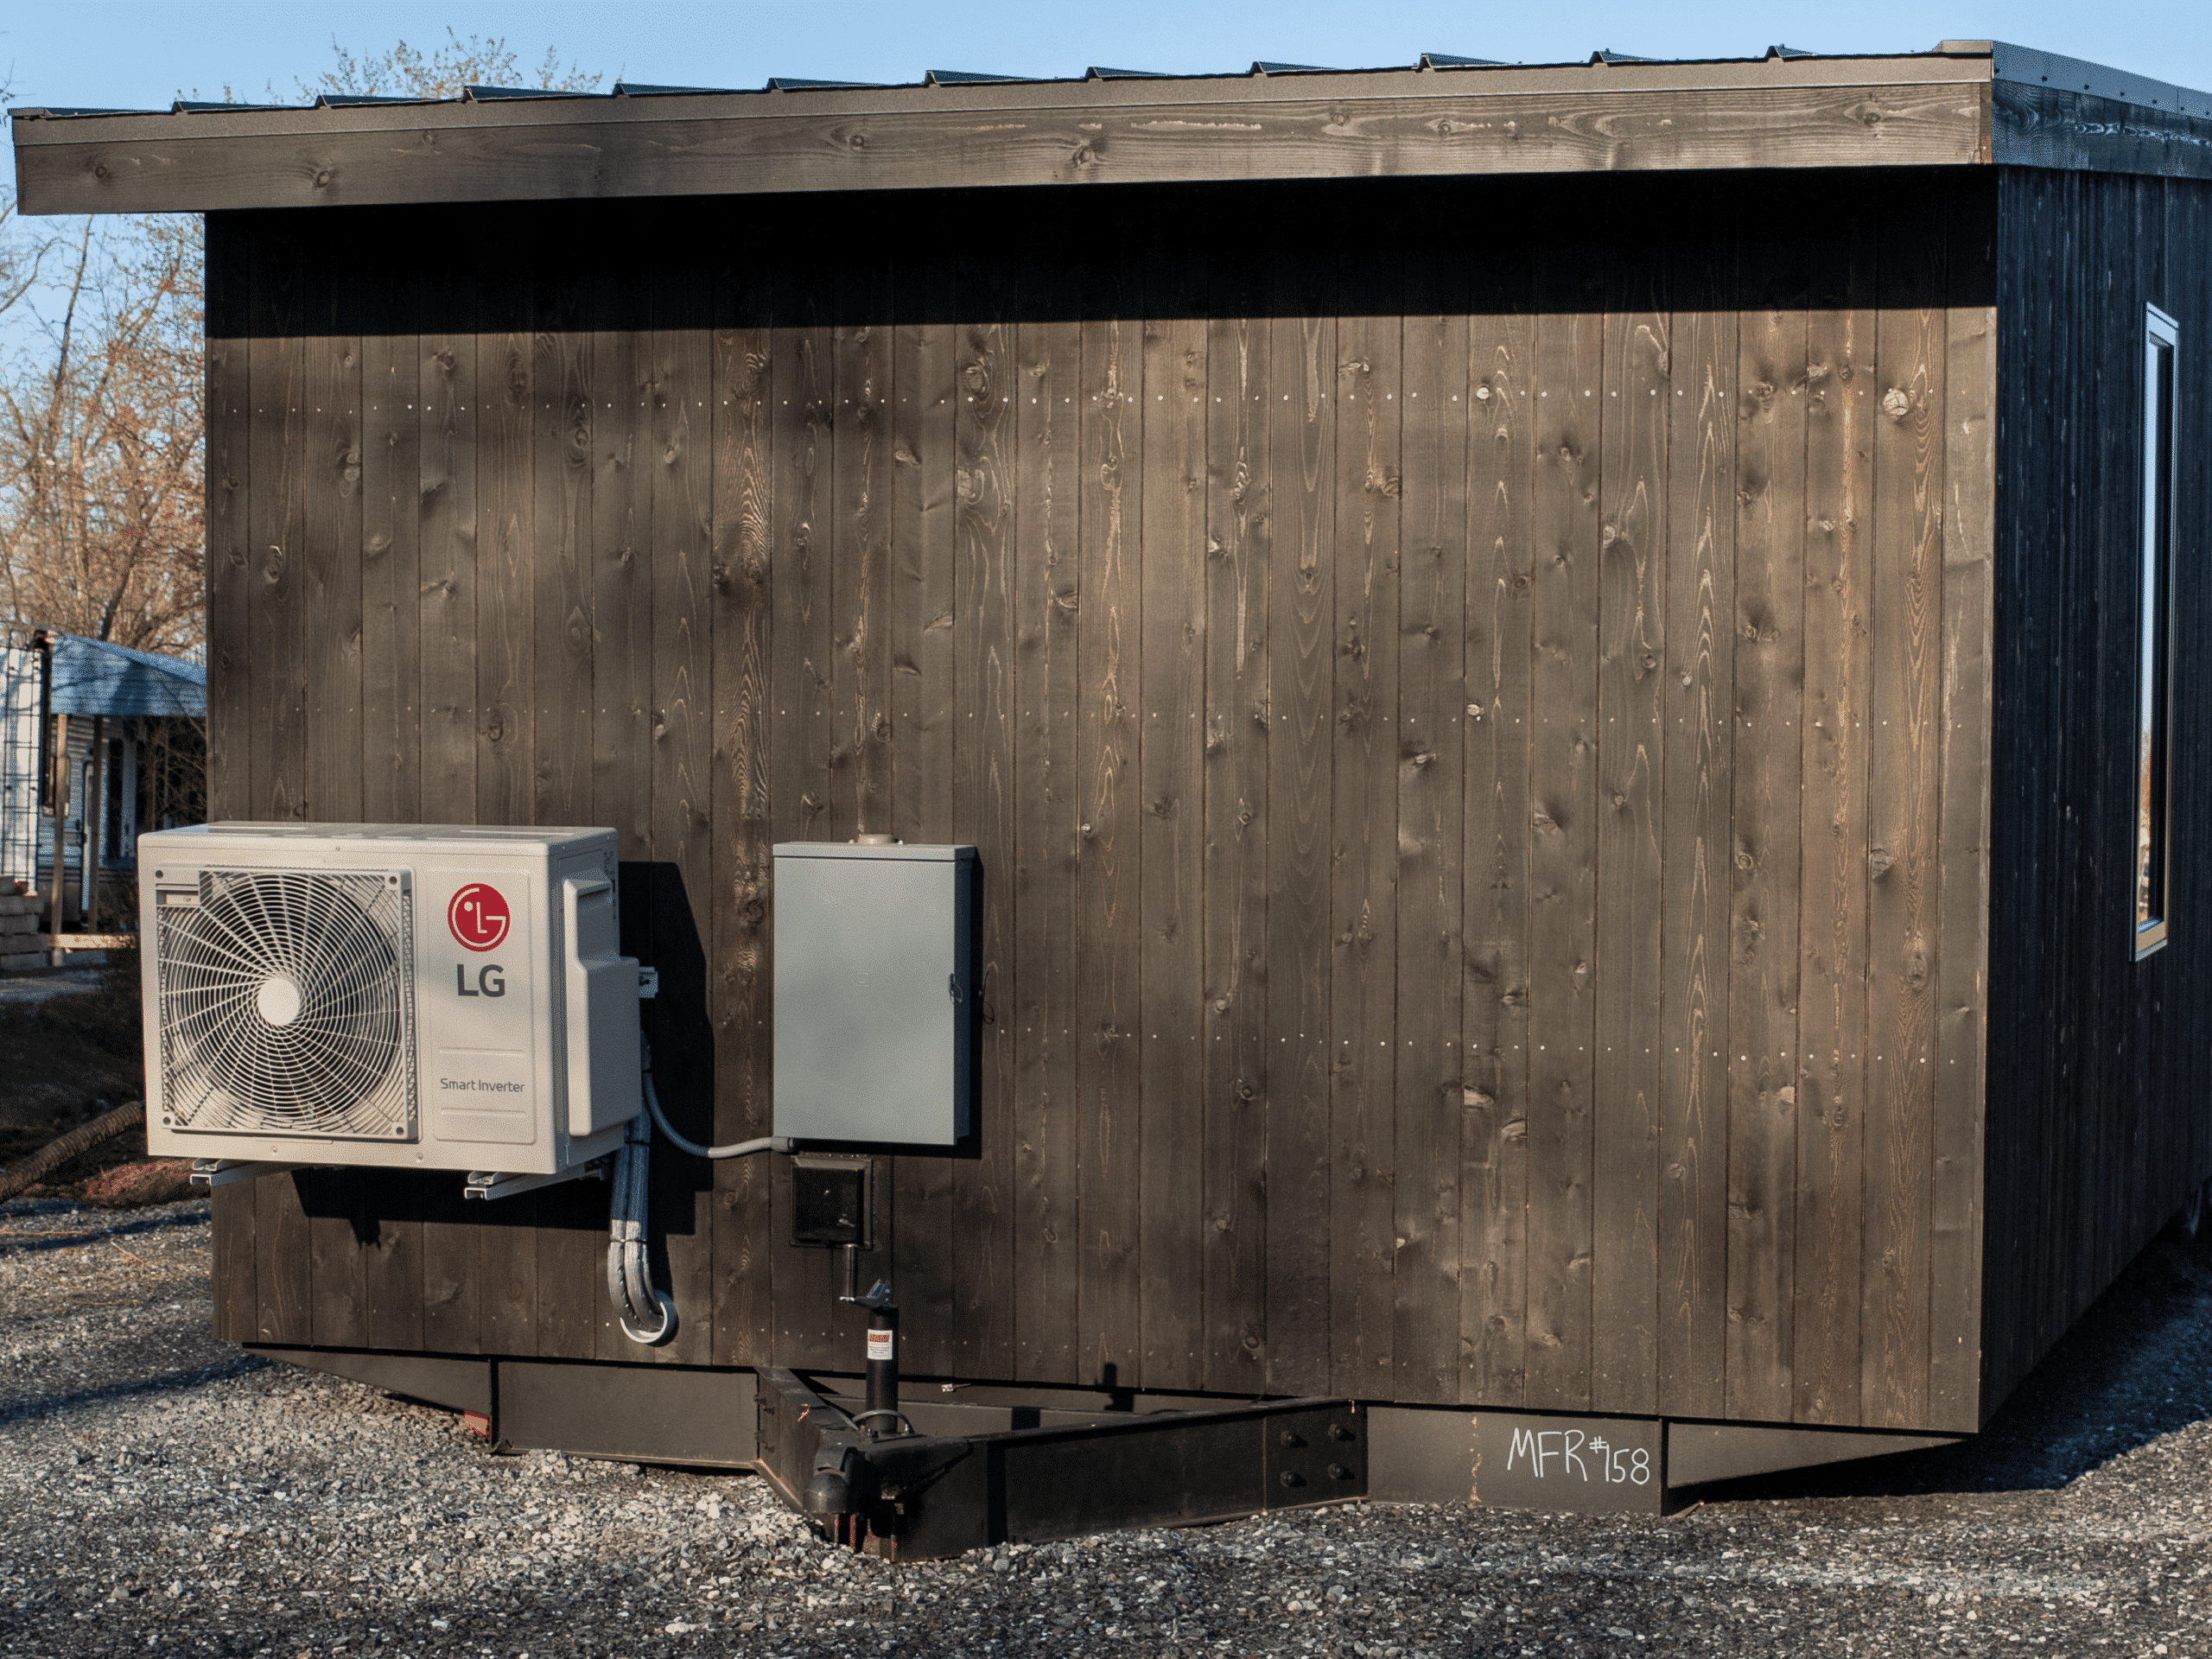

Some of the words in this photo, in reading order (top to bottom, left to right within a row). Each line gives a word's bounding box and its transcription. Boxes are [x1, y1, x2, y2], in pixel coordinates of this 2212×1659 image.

[456, 963, 505, 998] LG
[440, 1077, 476, 1090] Smart
[478, 1079, 525, 1092] Inverter
